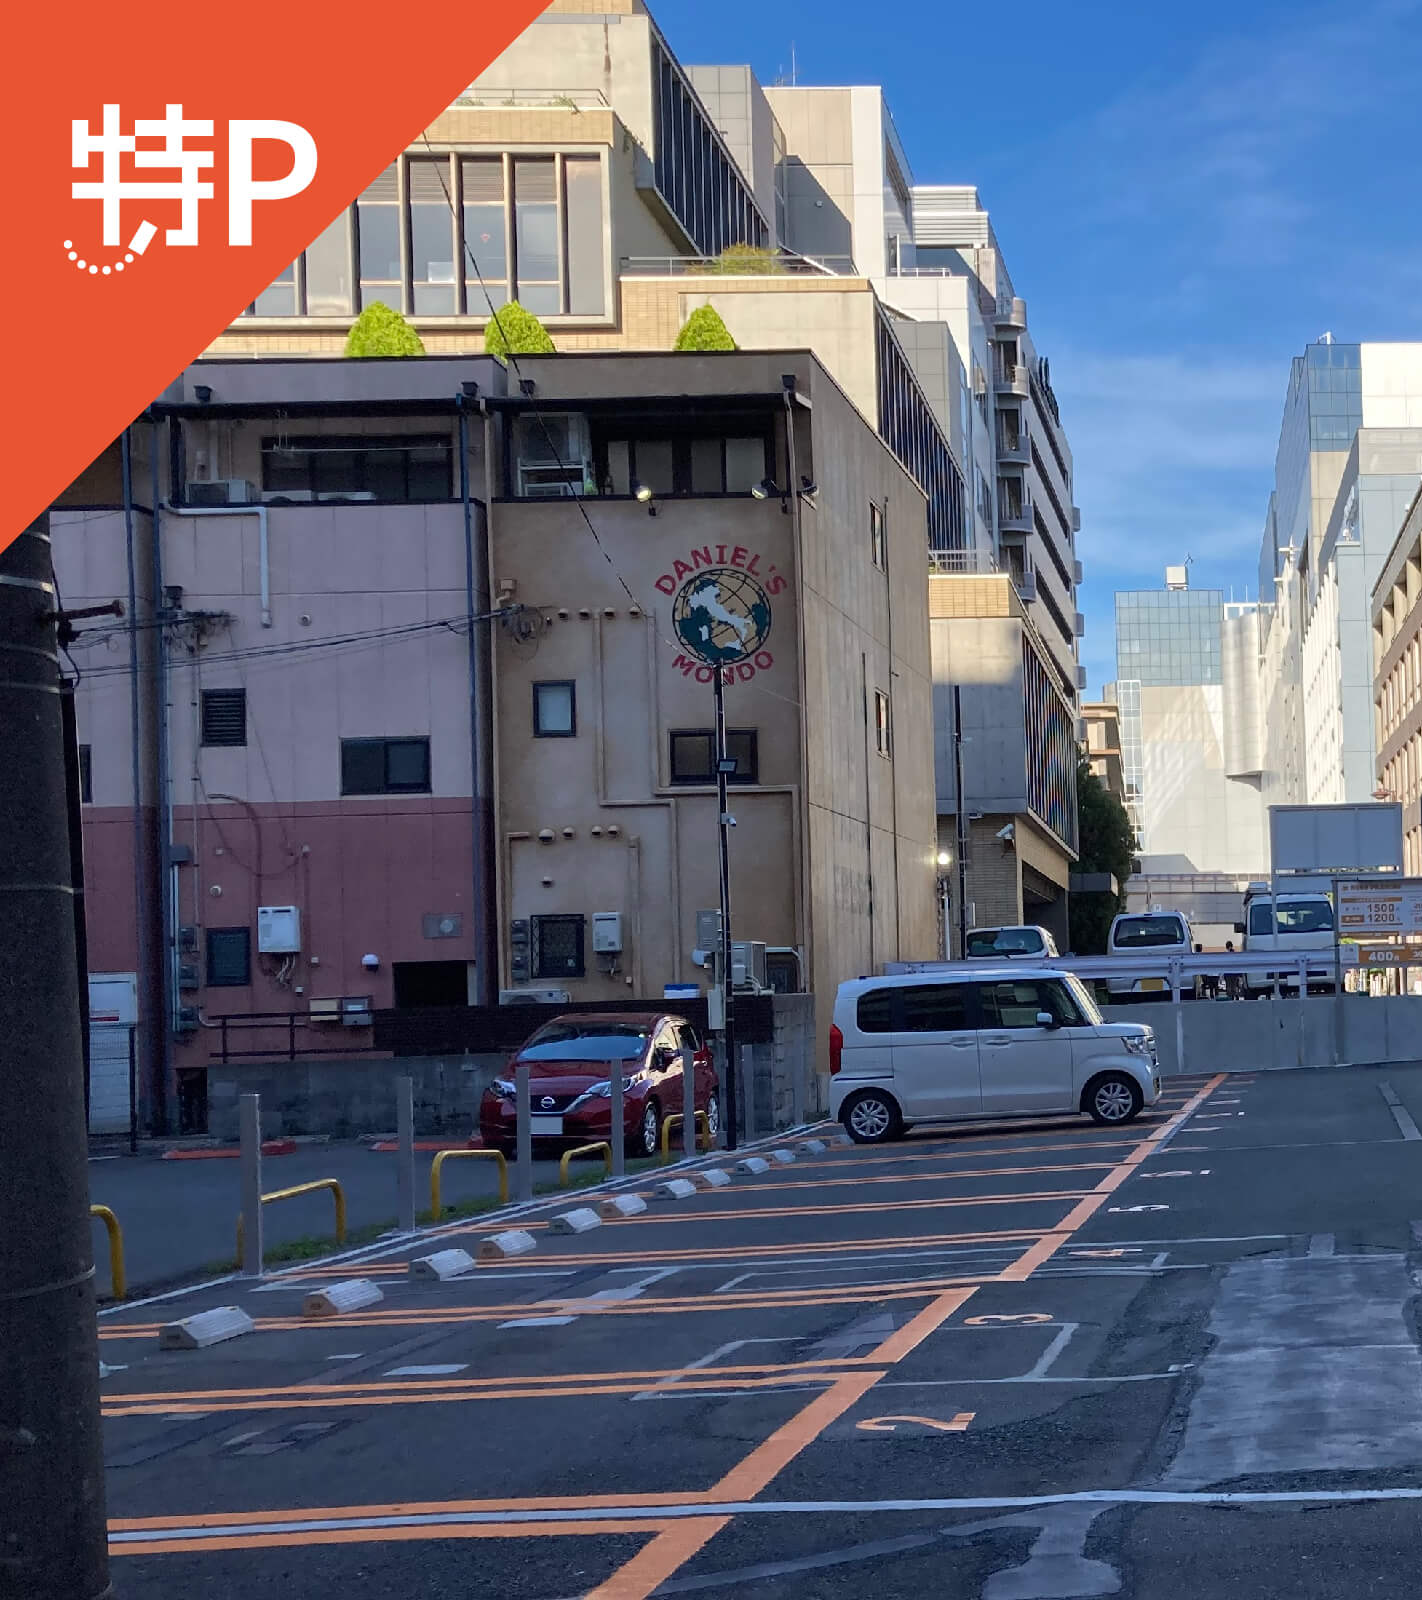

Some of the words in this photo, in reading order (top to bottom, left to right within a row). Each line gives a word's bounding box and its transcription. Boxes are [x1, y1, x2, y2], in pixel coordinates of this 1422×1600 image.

[654, 544, 787, 596] DANIEL'S
[671, 650, 774, 686] MONDO
[963, 1313, 1054, 1325] 3
[855, 1412, 976, 1432] 2
